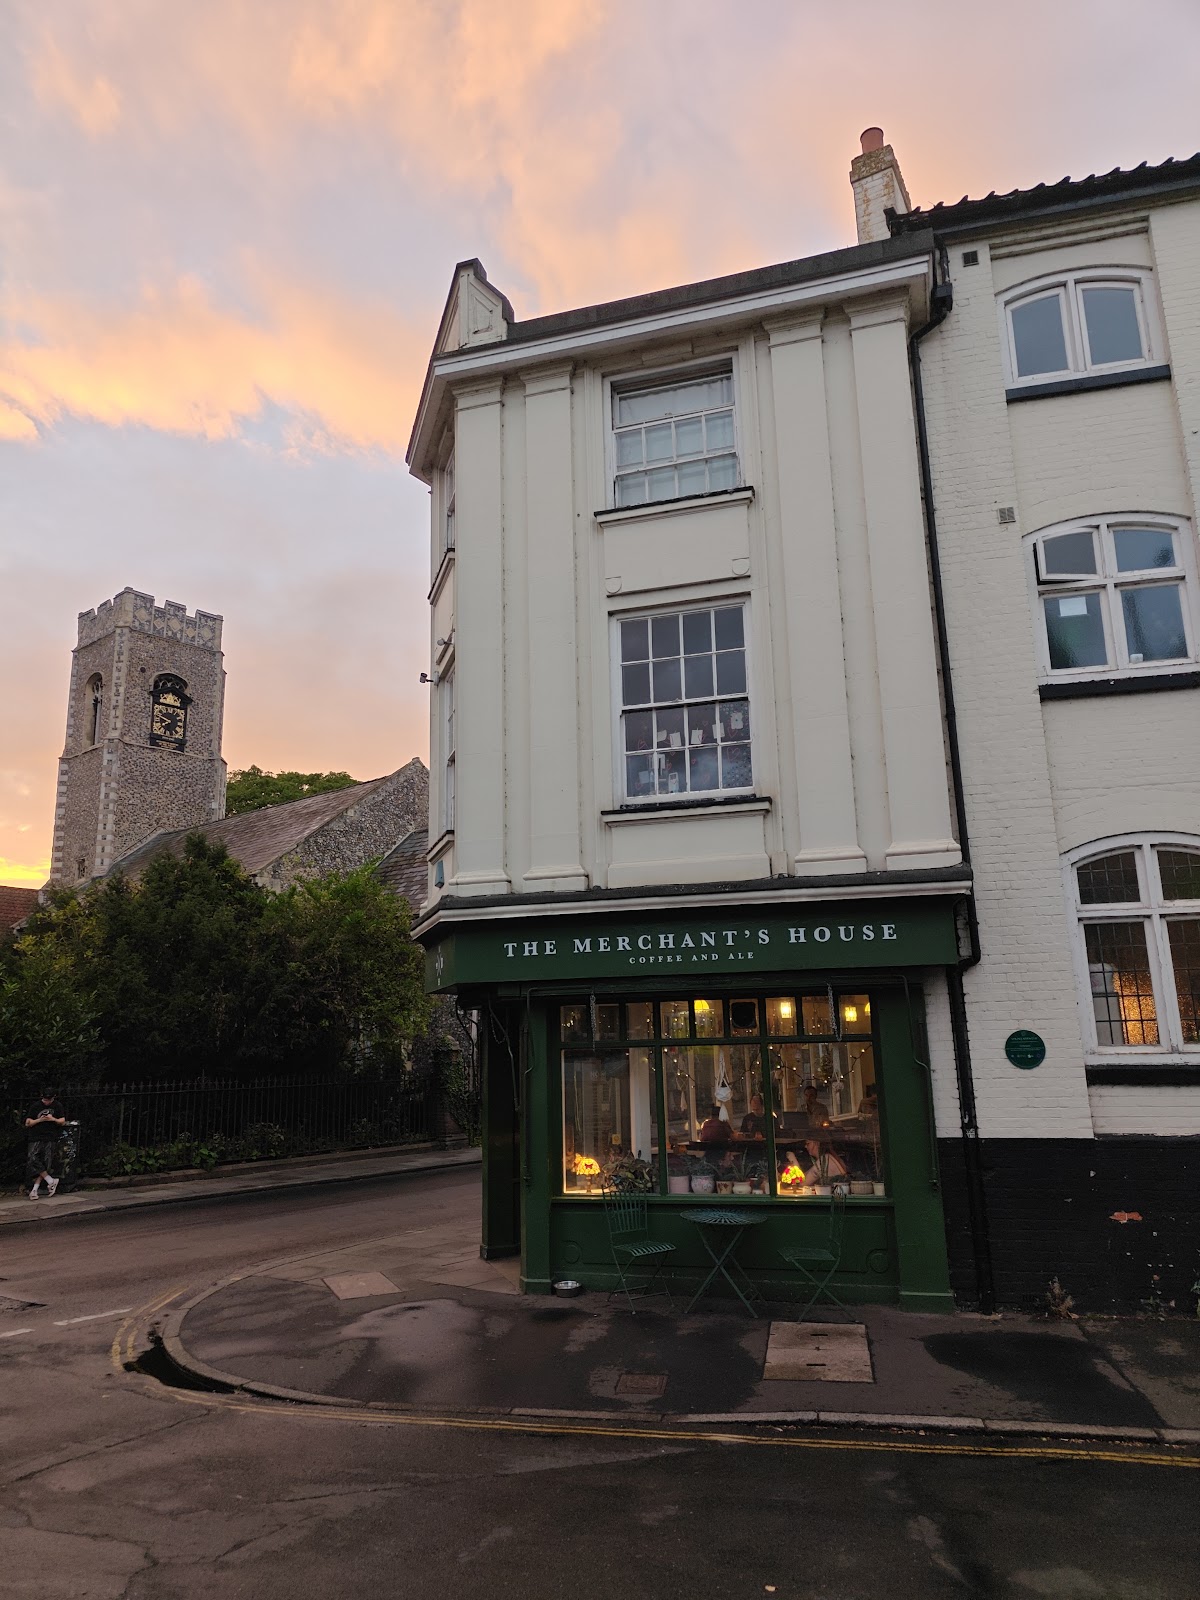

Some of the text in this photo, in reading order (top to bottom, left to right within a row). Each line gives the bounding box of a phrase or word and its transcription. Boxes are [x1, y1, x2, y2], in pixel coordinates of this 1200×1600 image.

[503, 924, 897, 958] THE MERCHANT'S HOUSE
[628, 951, 755, 965] COFFEE AND ALE
